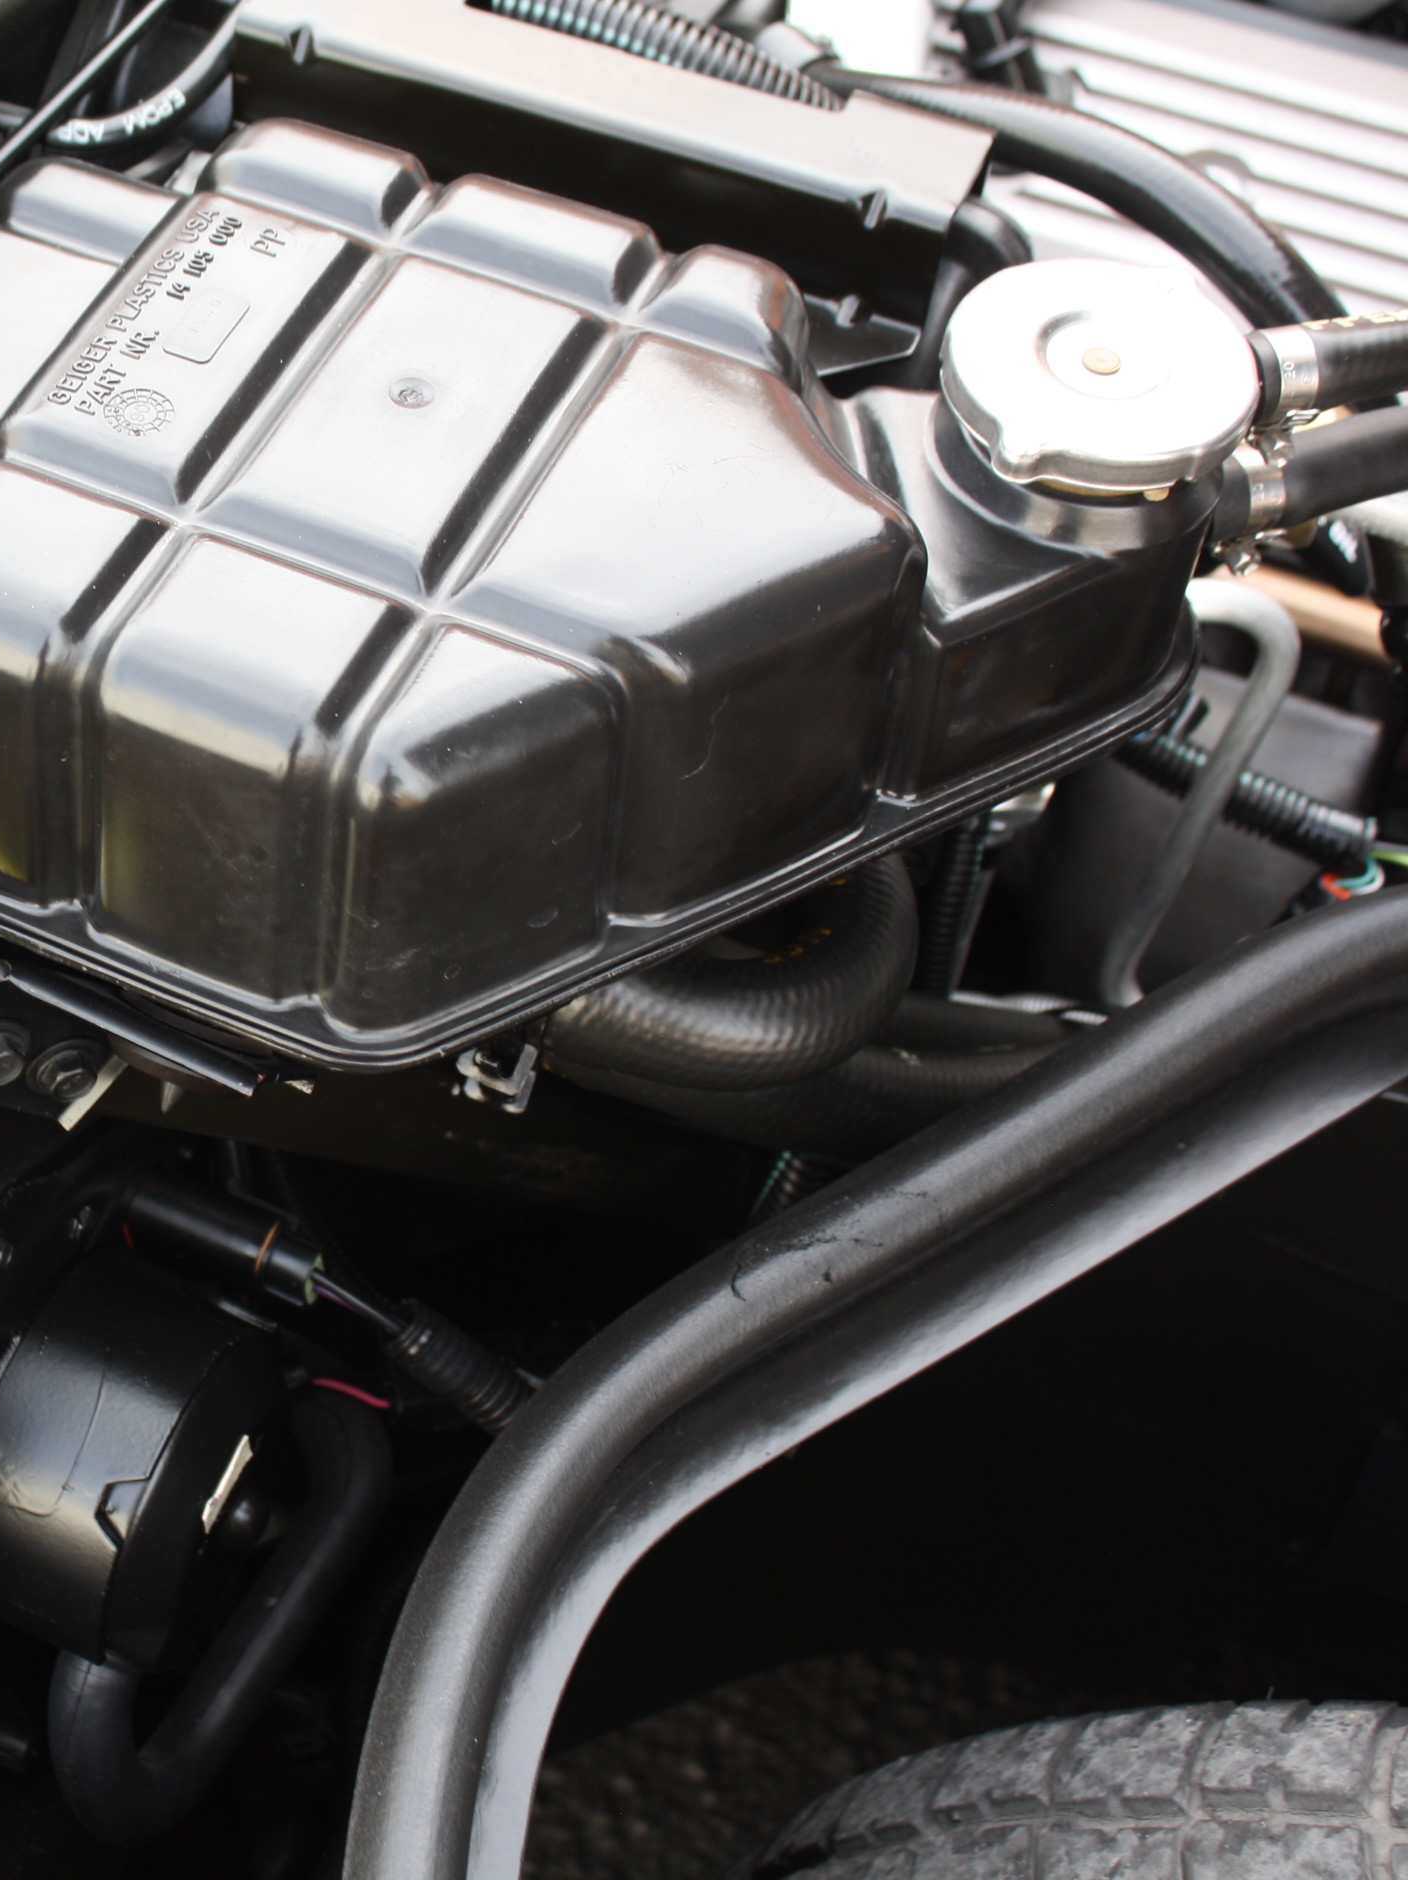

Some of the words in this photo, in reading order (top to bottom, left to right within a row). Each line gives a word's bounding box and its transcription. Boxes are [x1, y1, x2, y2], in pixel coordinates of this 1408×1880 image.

[48, 337, 117, 404] GEIGER
[107, 248, 184, 332] PLASTICS
[177, 207, 219, 243] USA
[74, 363, 126, 416] PART
[120, 329, 159, 360] NR.
[166, 281, 191, 301] 14
[183, 250, 214, 278] 105
[209, 215, 242, 246] 000
